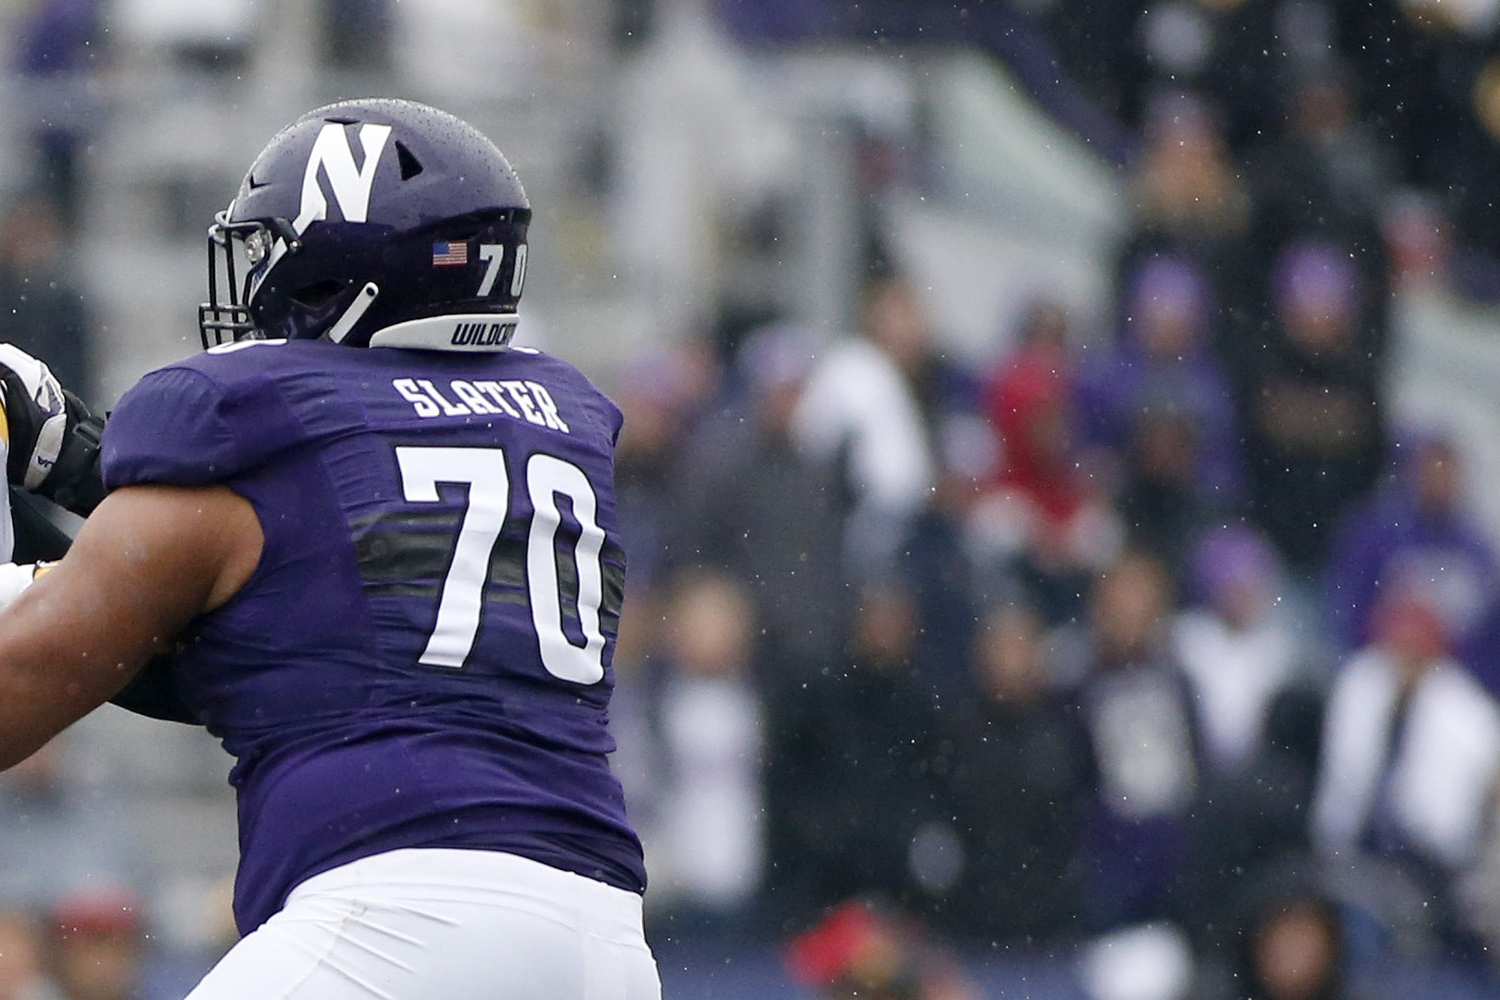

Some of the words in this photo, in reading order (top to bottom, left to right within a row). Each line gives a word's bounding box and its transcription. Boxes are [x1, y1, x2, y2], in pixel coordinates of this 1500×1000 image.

[299, 122, 393, 224] N
[476, 244, 528, 297] 70
[392, 378, 571, 434] SLATER
[395, 446, 607, 685] 70
